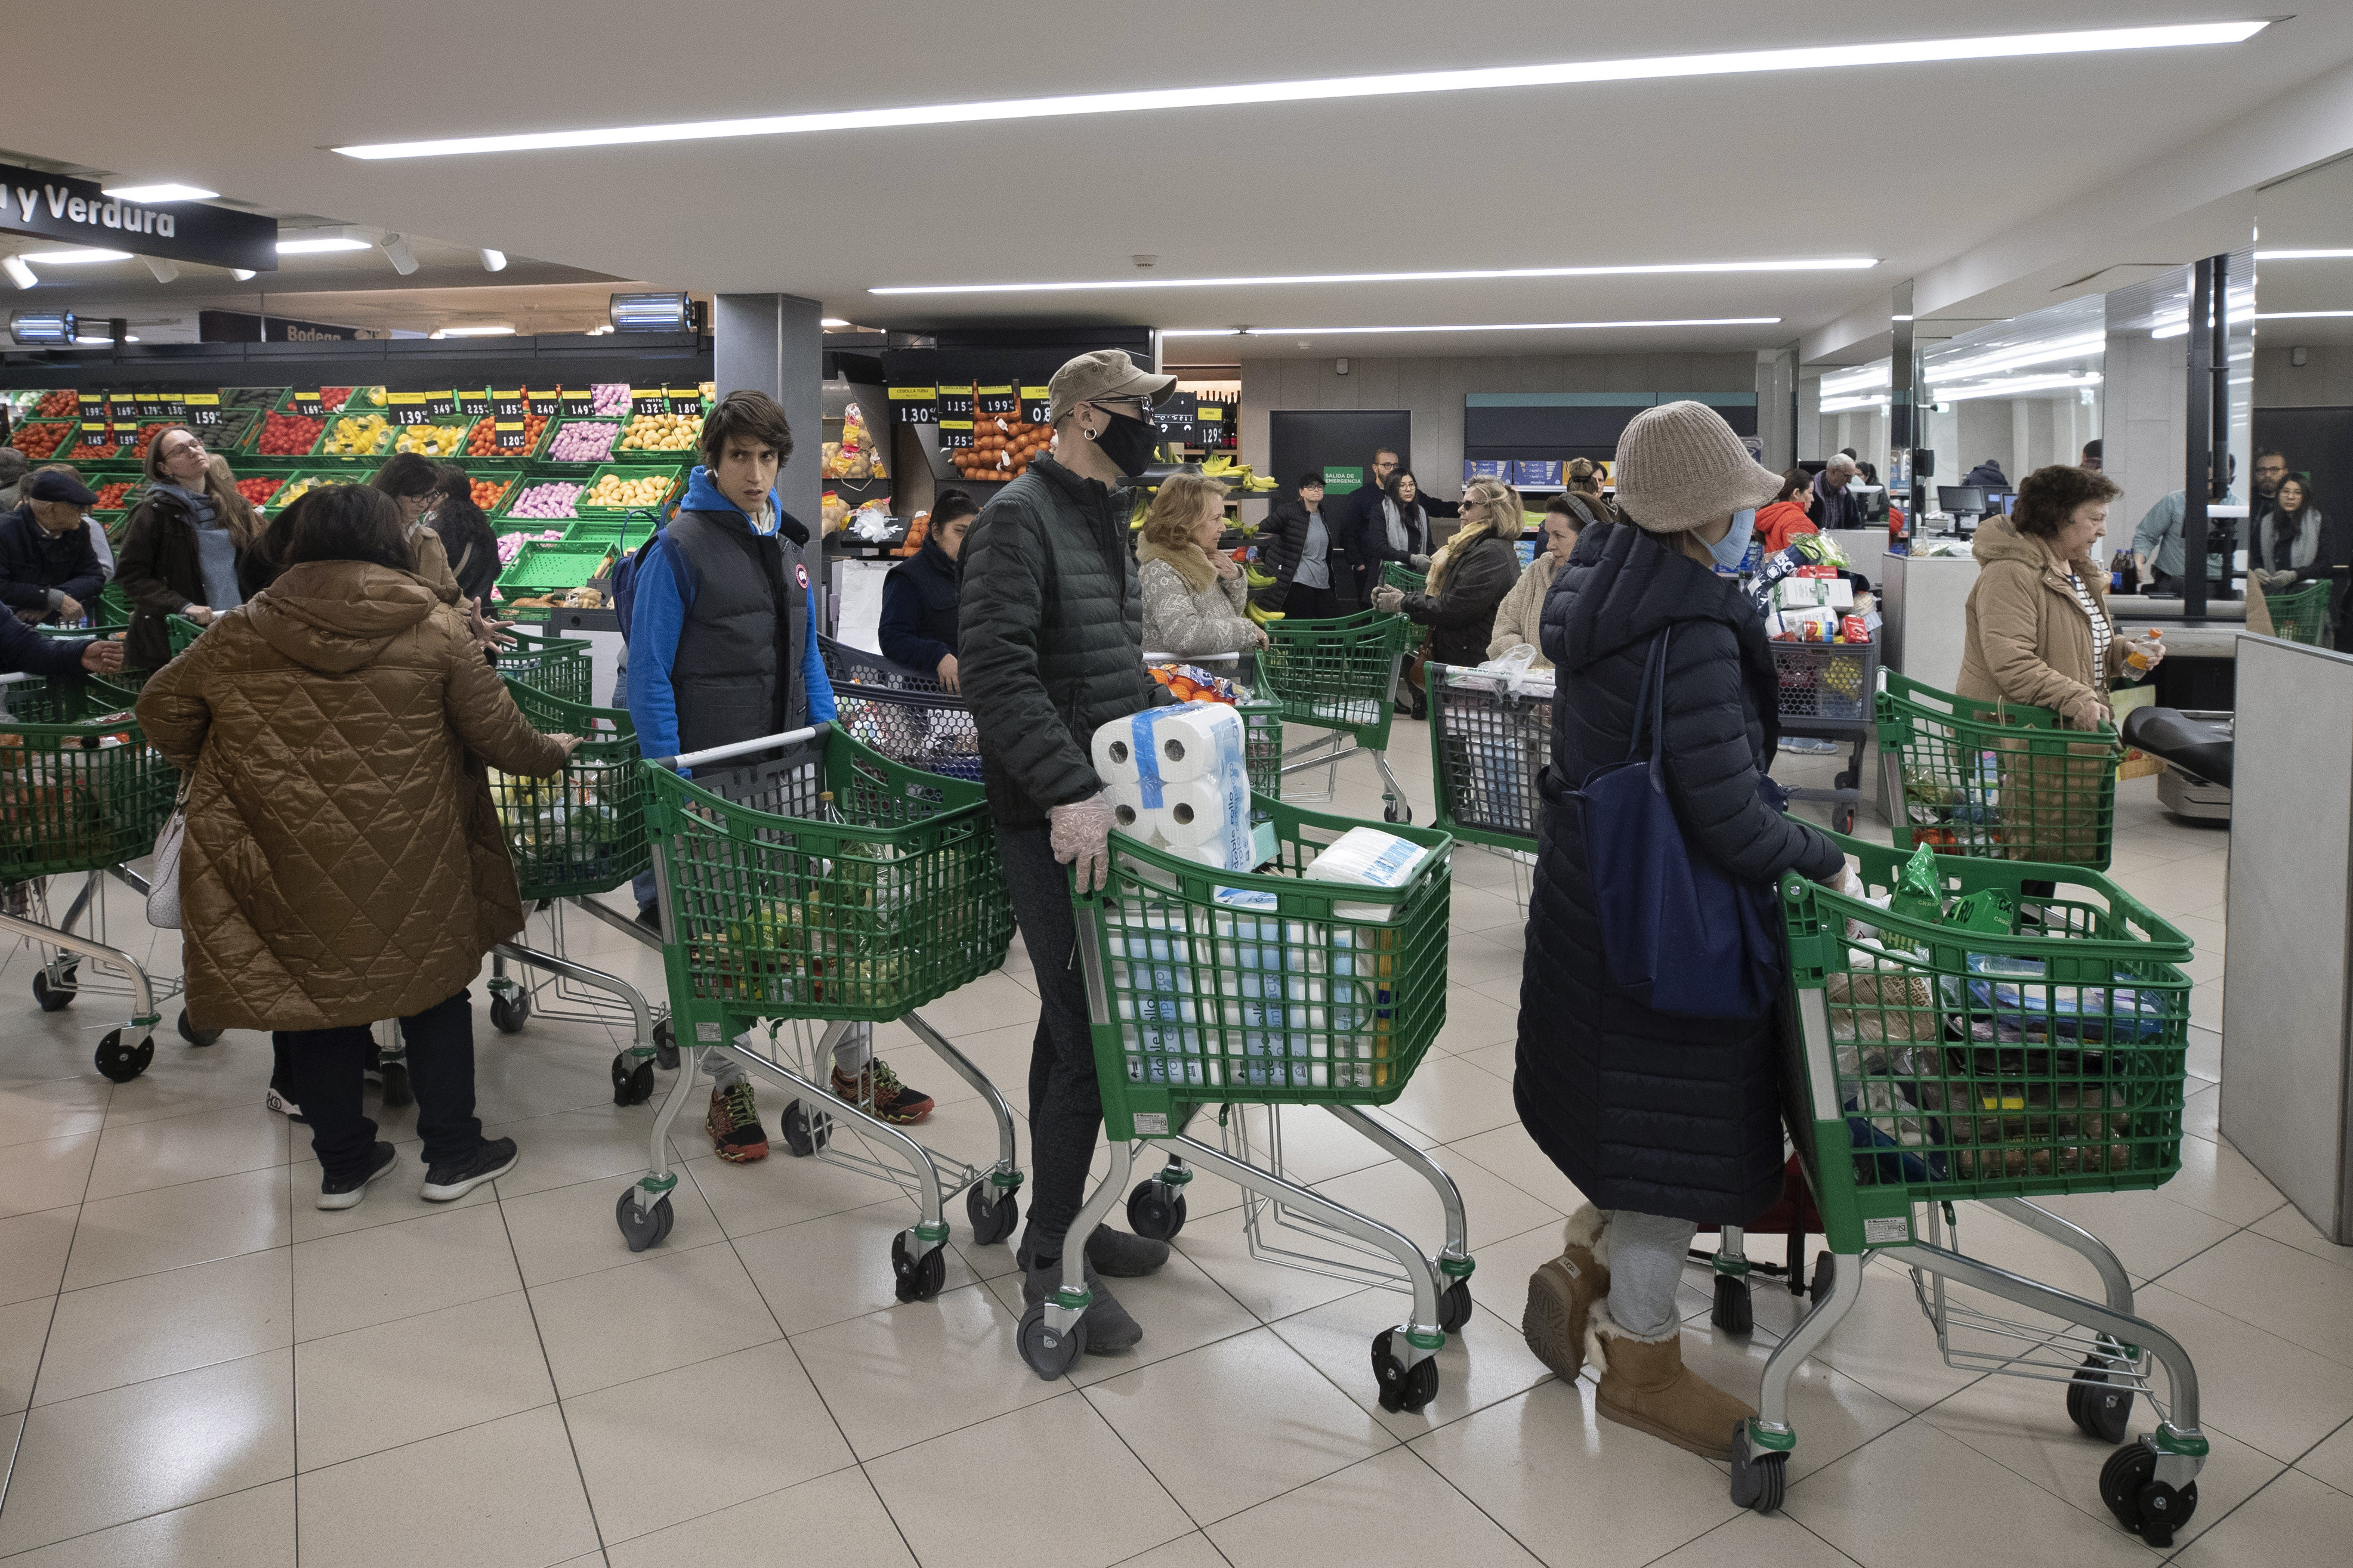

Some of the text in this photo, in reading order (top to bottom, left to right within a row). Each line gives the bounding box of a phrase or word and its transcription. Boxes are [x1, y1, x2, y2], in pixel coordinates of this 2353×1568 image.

[16, 187, 38, 222] y
[44, 184, 175, 237] Verdura
[1230, 830, 1239, 869] doble
[1150, 1037, 1165, 1076] dole
[1168, 1047, 1179, 1077] roo
[1276, 1047, 1285, 1076] roo
